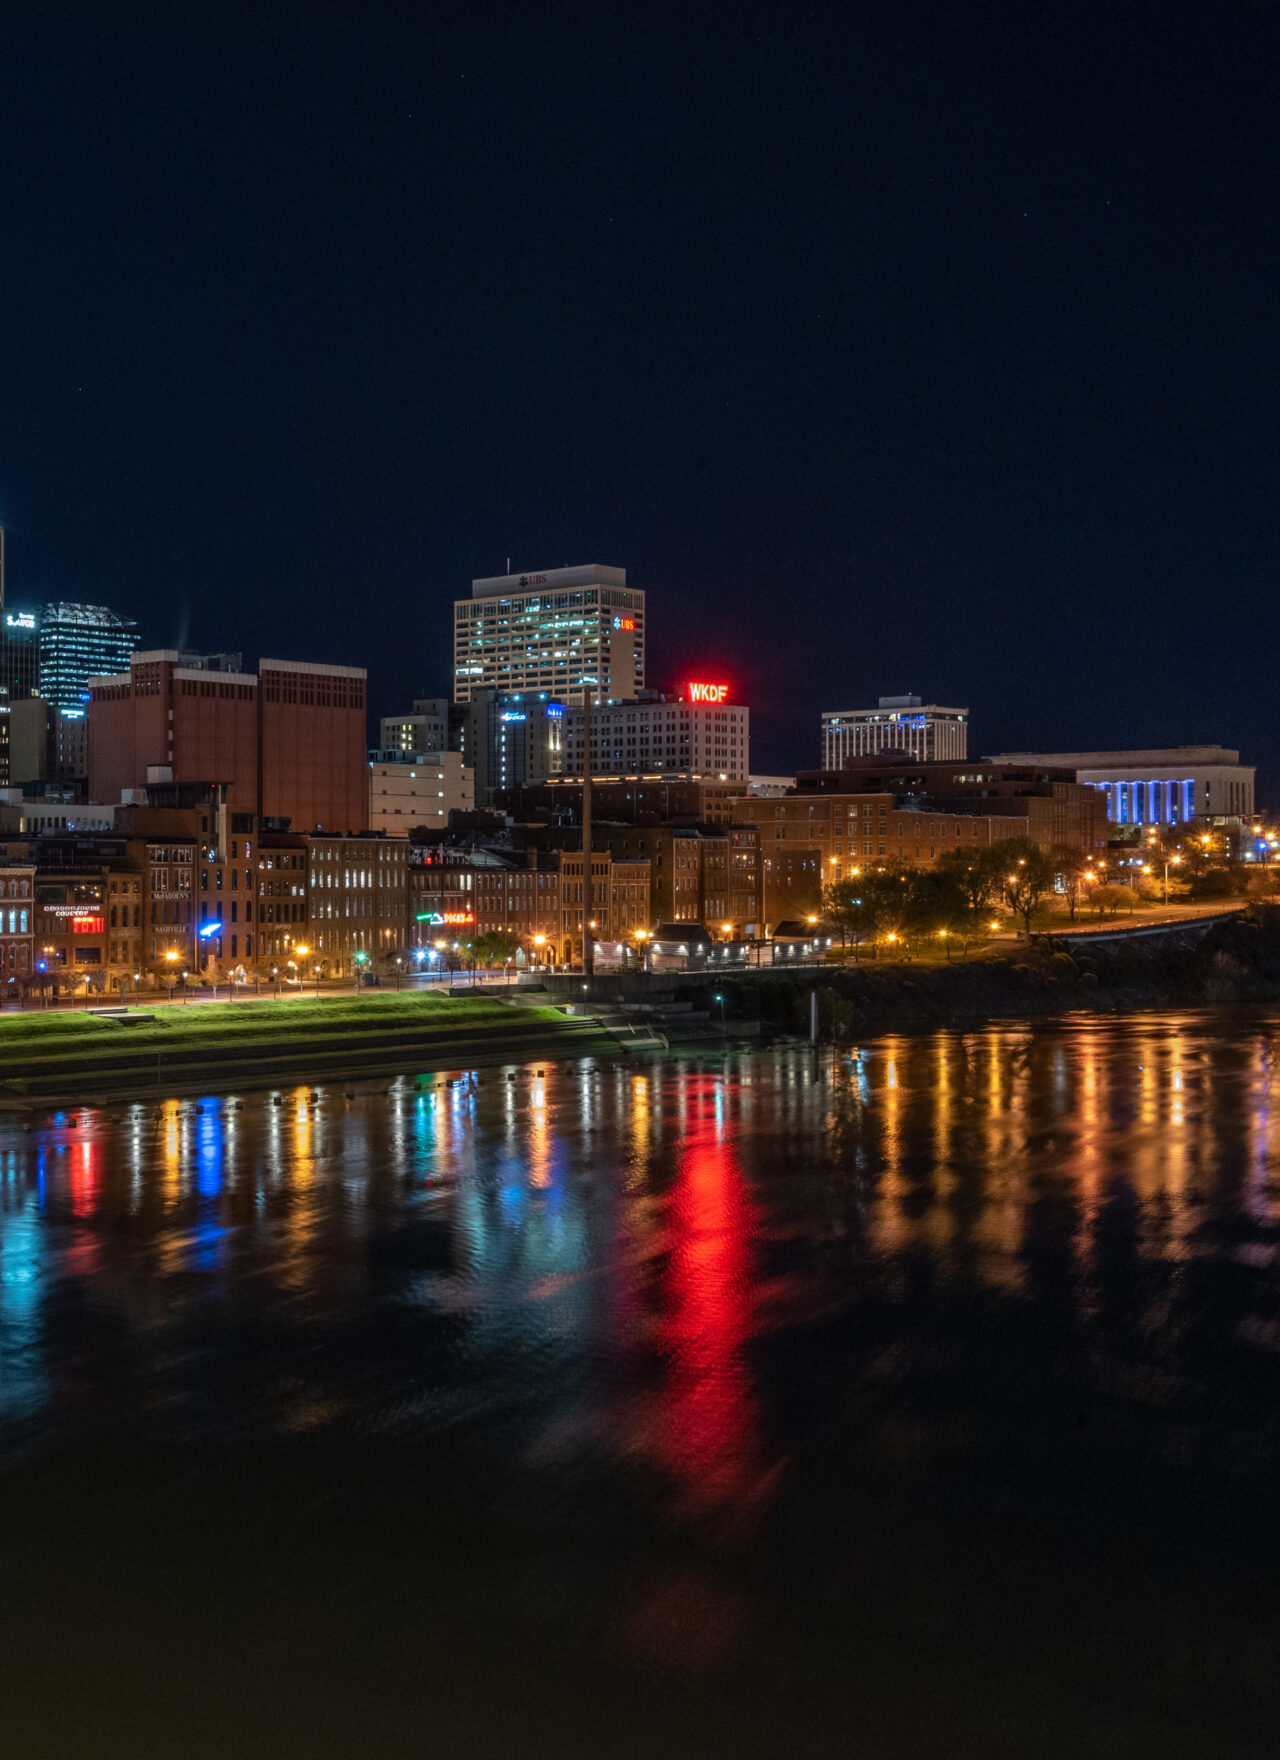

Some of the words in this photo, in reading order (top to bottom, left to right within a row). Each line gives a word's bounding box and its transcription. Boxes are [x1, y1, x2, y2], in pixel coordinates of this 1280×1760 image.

[528, 575, 548, 585] UBS
[621, 618, 635, 631] UBS
[690, 682, 728, 702] WKDF
